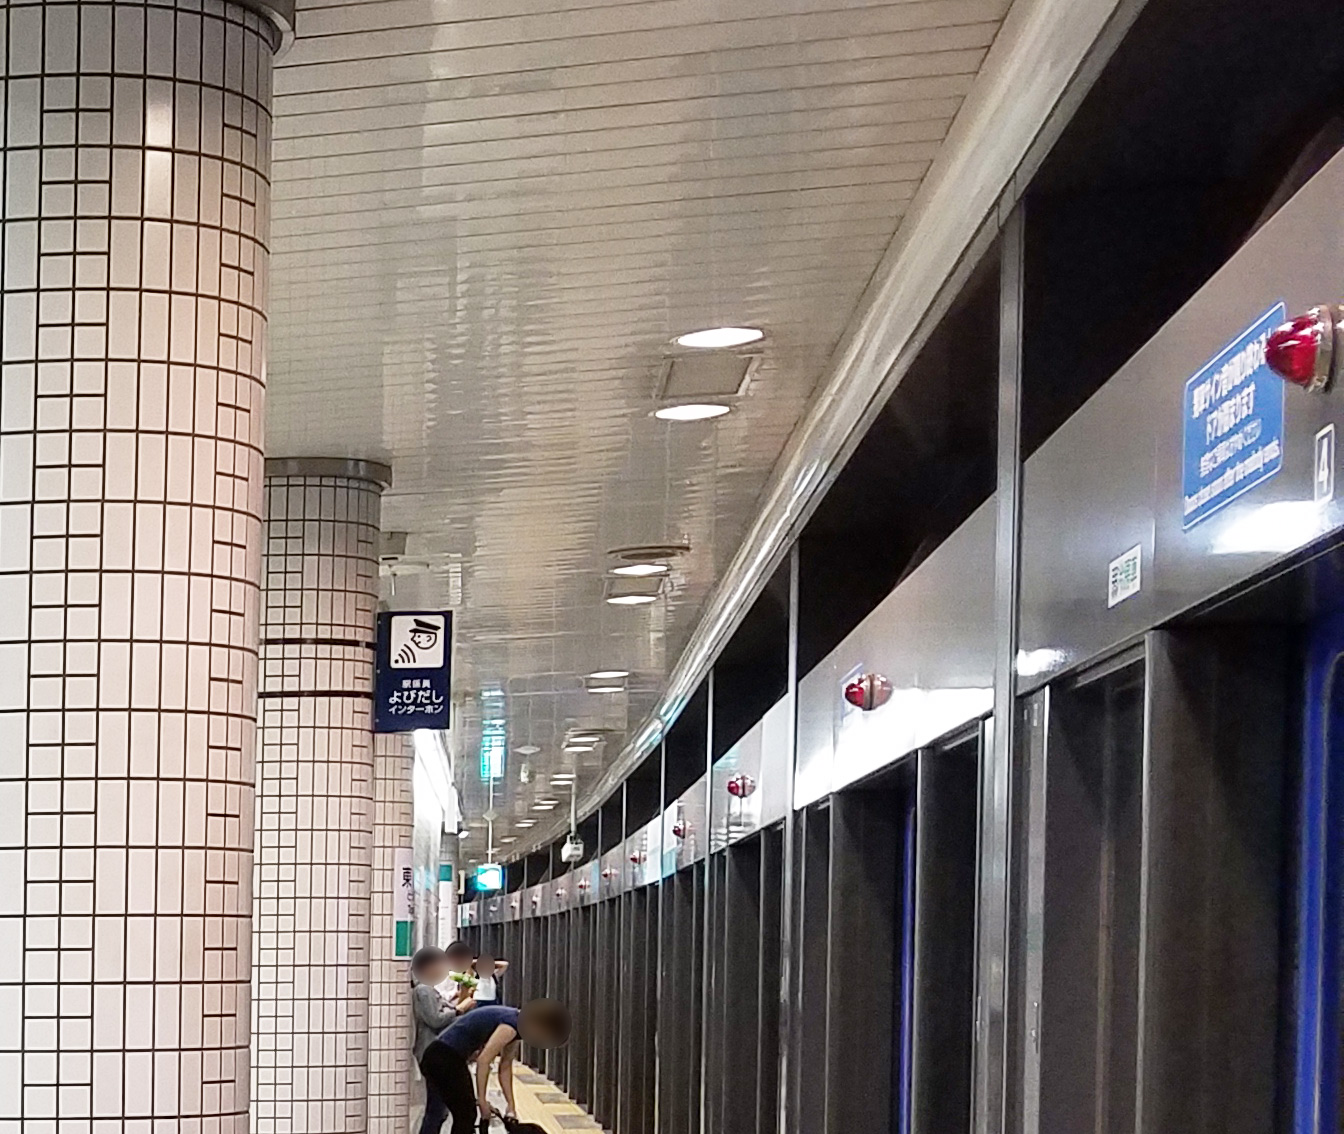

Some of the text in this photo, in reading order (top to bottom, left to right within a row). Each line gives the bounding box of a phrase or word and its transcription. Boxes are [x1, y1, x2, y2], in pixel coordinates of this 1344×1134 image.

[1318, 438, 1329, 493] 4
[388, 690, 444, 704] よびだし
[388, 704, 444, 714] インターホン
